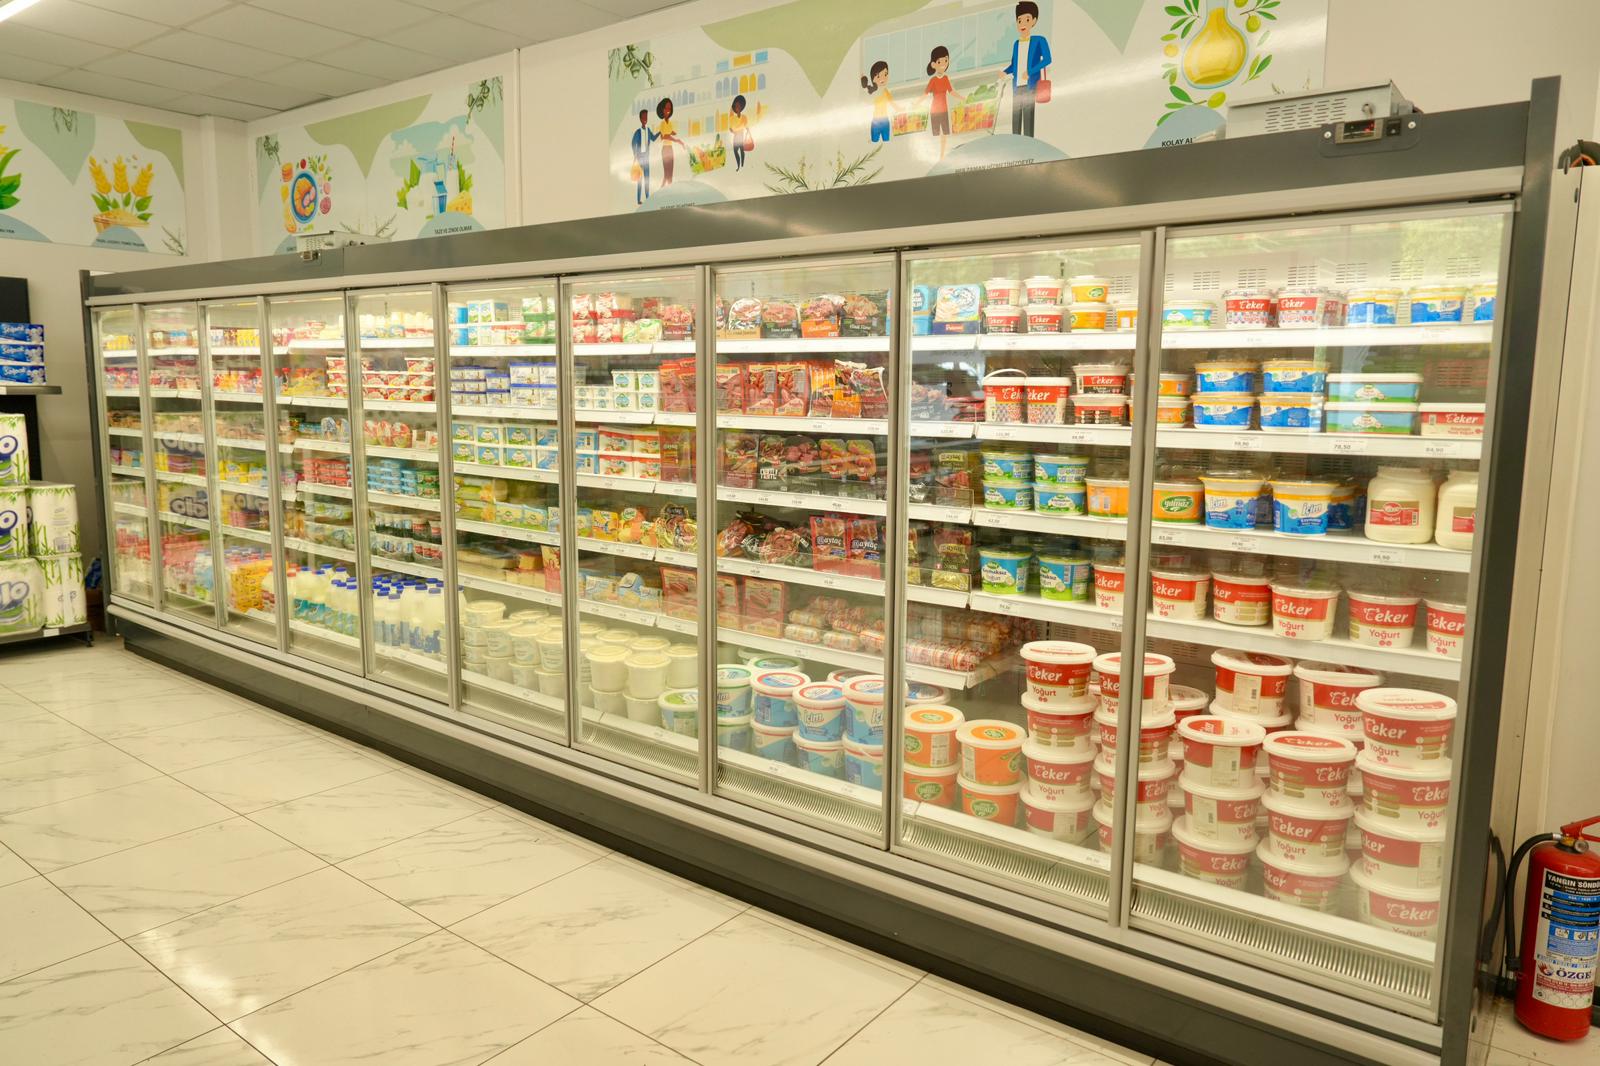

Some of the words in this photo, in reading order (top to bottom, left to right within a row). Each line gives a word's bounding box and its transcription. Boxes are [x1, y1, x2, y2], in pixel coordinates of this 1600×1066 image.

[1162, 138, 1182, 147] KOLAY
[1445, 412, 1479, 424] Teker
[1275, 598, 1313, 615] Teker
[1363, 607, 1409, 623] Teker
[1279, 620, 1305, 631] Yoğurt
[1369, 628, 1401, 640] Yoğurt
[1028, 664, 1063, 682] Teker
[1032, 684, 1057, 697] Yoğurt
[1334, 713, 1361, 725] Yoğur
[1363, 717, 1407, 740] Teker
[1369, 743, 1400, 758] Yoğurt
[1034, 764, 1071, 781] Teker
[1038, 783, 1065, 796] Yoğurt
[1271, 815, 1313, 838] Teker
[1276, 839, 1307, 855] Yoğurt
[1547, 873, 1576, 888] YANGIN
[1386, 902, 1435, 921] Teker
[1556, 967, 1592, 980] ÖZGE
